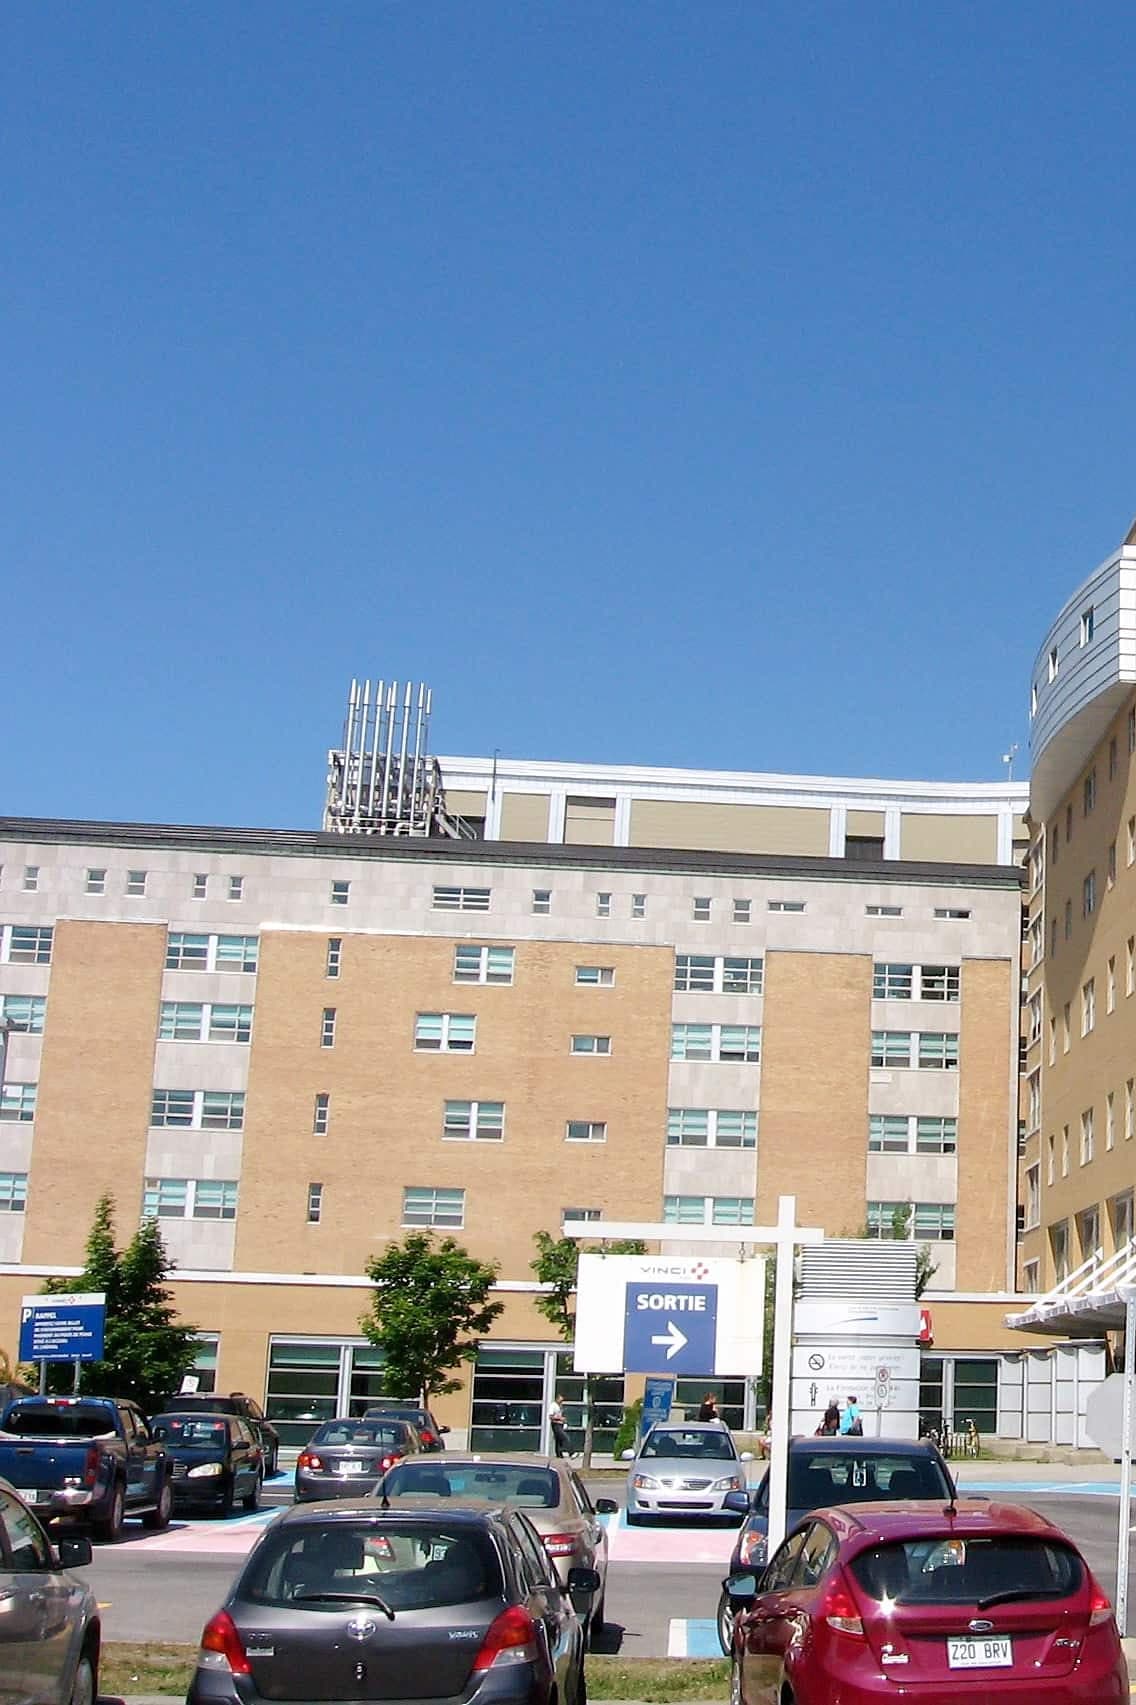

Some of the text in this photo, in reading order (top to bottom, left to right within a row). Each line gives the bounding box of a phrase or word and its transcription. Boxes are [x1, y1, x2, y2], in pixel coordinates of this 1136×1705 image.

[640, 1267, 686, 1275] VINCI
[636, 1294, 706, 1311] SORTIE
[23, 1308, 32, 1323] P
[951, 1642, 1008, 1660] Z20 BRV
